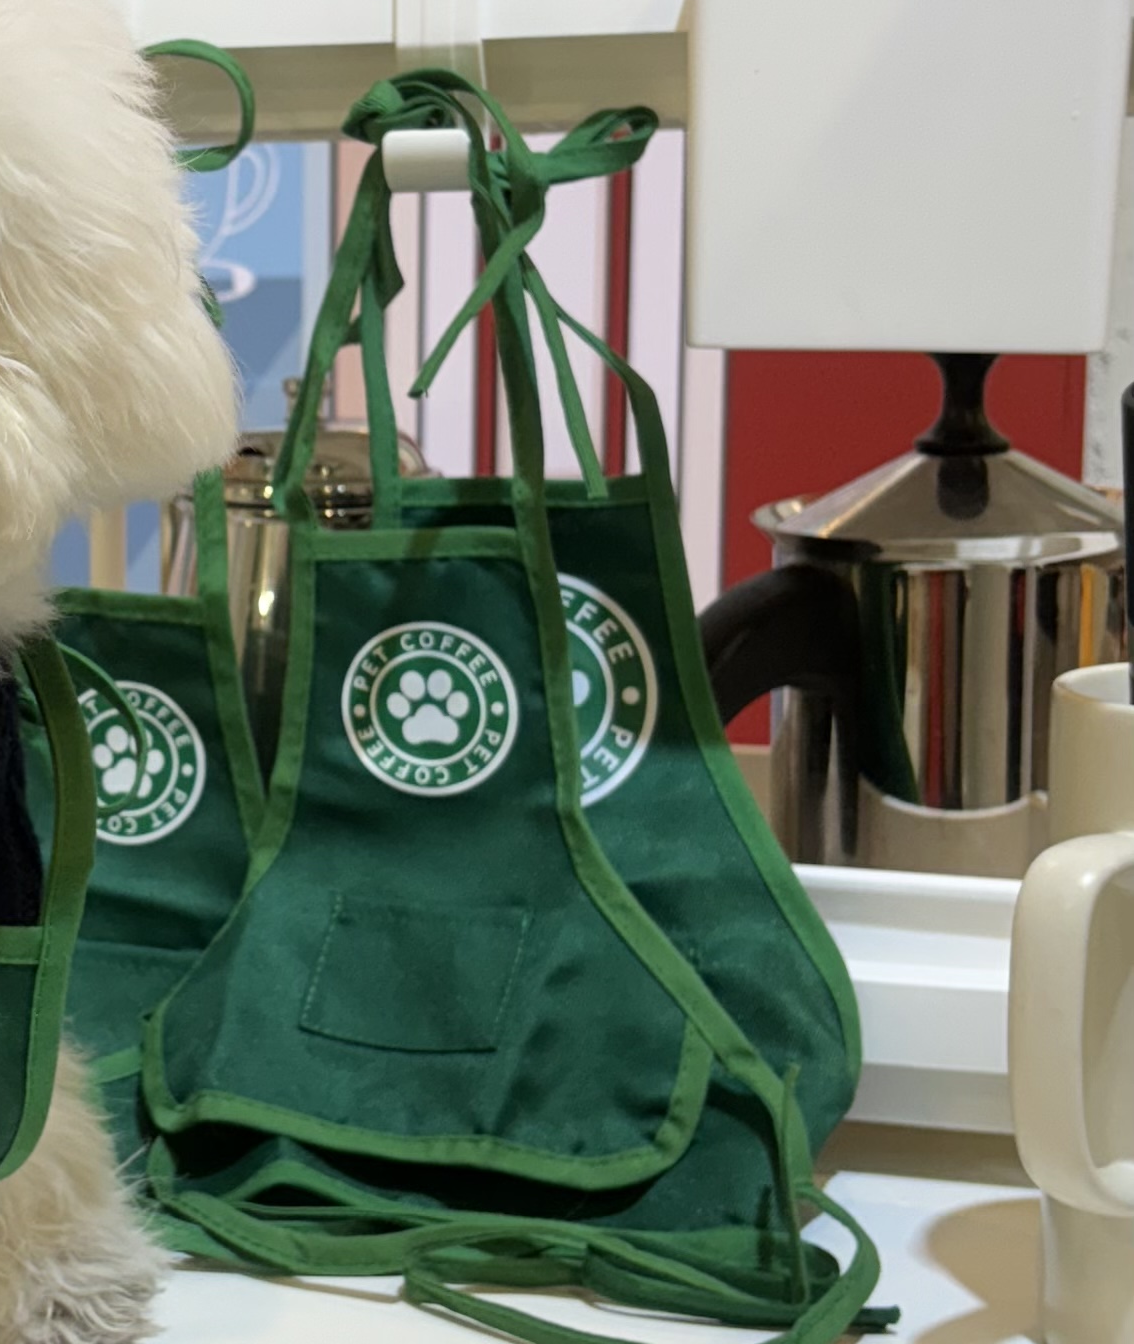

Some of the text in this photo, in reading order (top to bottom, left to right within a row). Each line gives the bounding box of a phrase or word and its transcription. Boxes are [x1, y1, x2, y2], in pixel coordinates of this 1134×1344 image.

[353, 631, 498, 692] PET COFFEE
[126, 690, 192, 748] OFFEE
[357, 725, 502, 785] PET COFFEE
